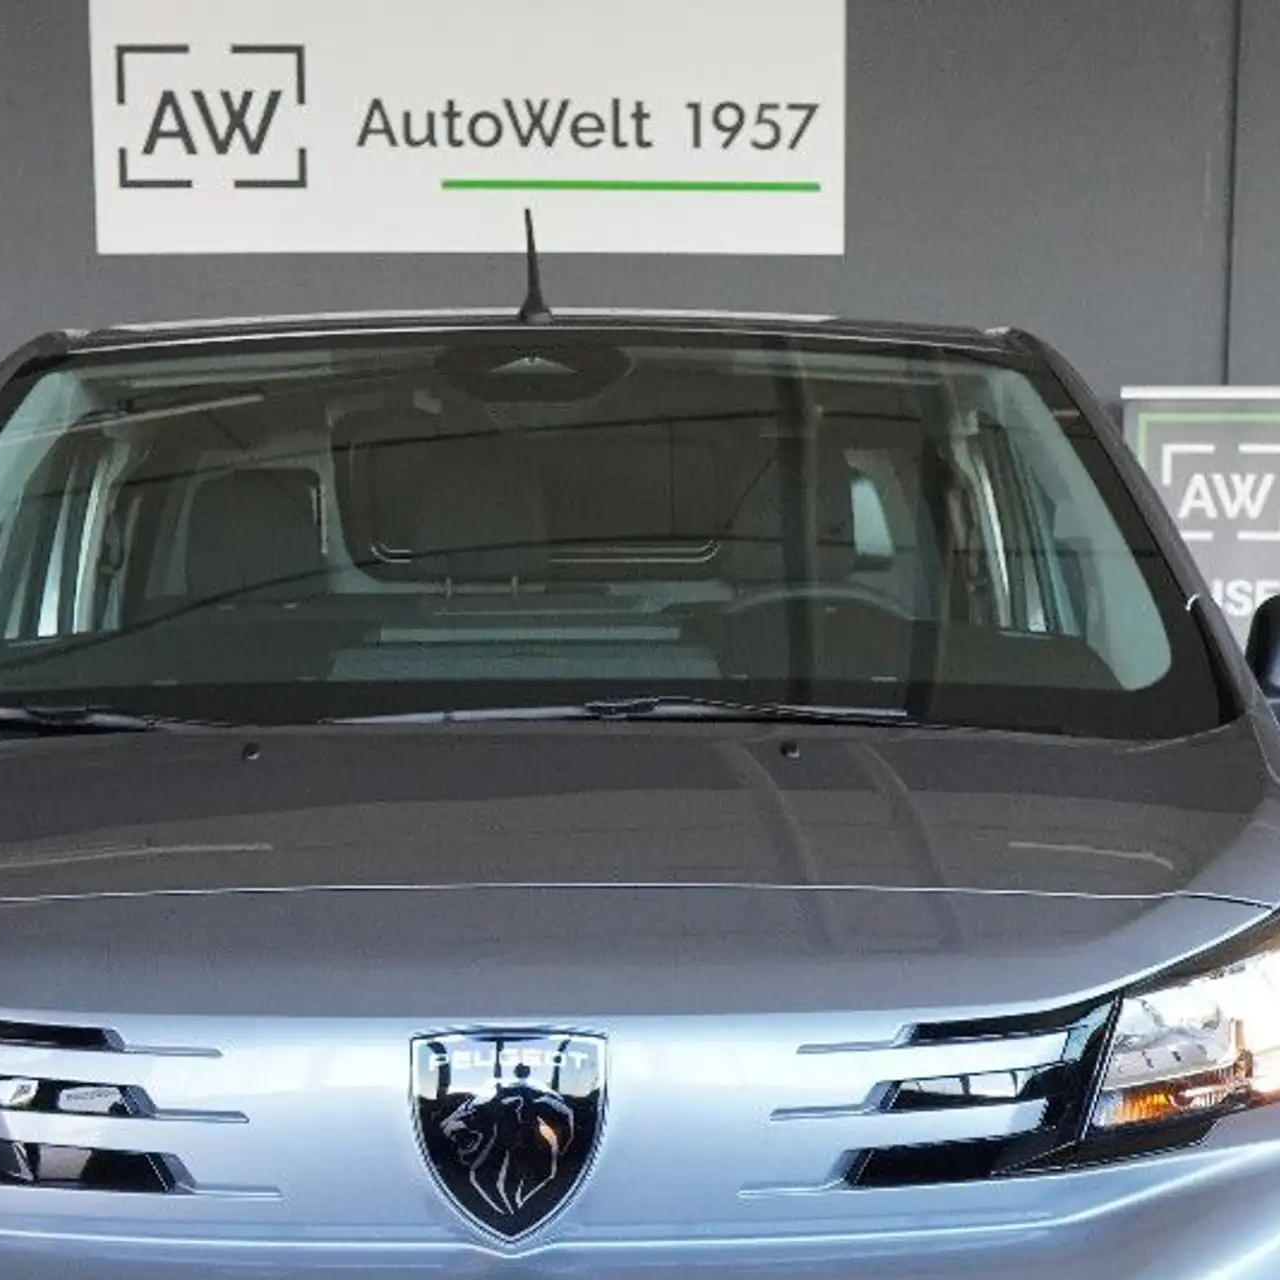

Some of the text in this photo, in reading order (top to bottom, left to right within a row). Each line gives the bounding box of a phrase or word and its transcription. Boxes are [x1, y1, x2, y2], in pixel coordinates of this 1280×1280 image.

[141, 90, 820, 155] AW AutoWelt 1957
[1179, 473, 1274, 519] AW
